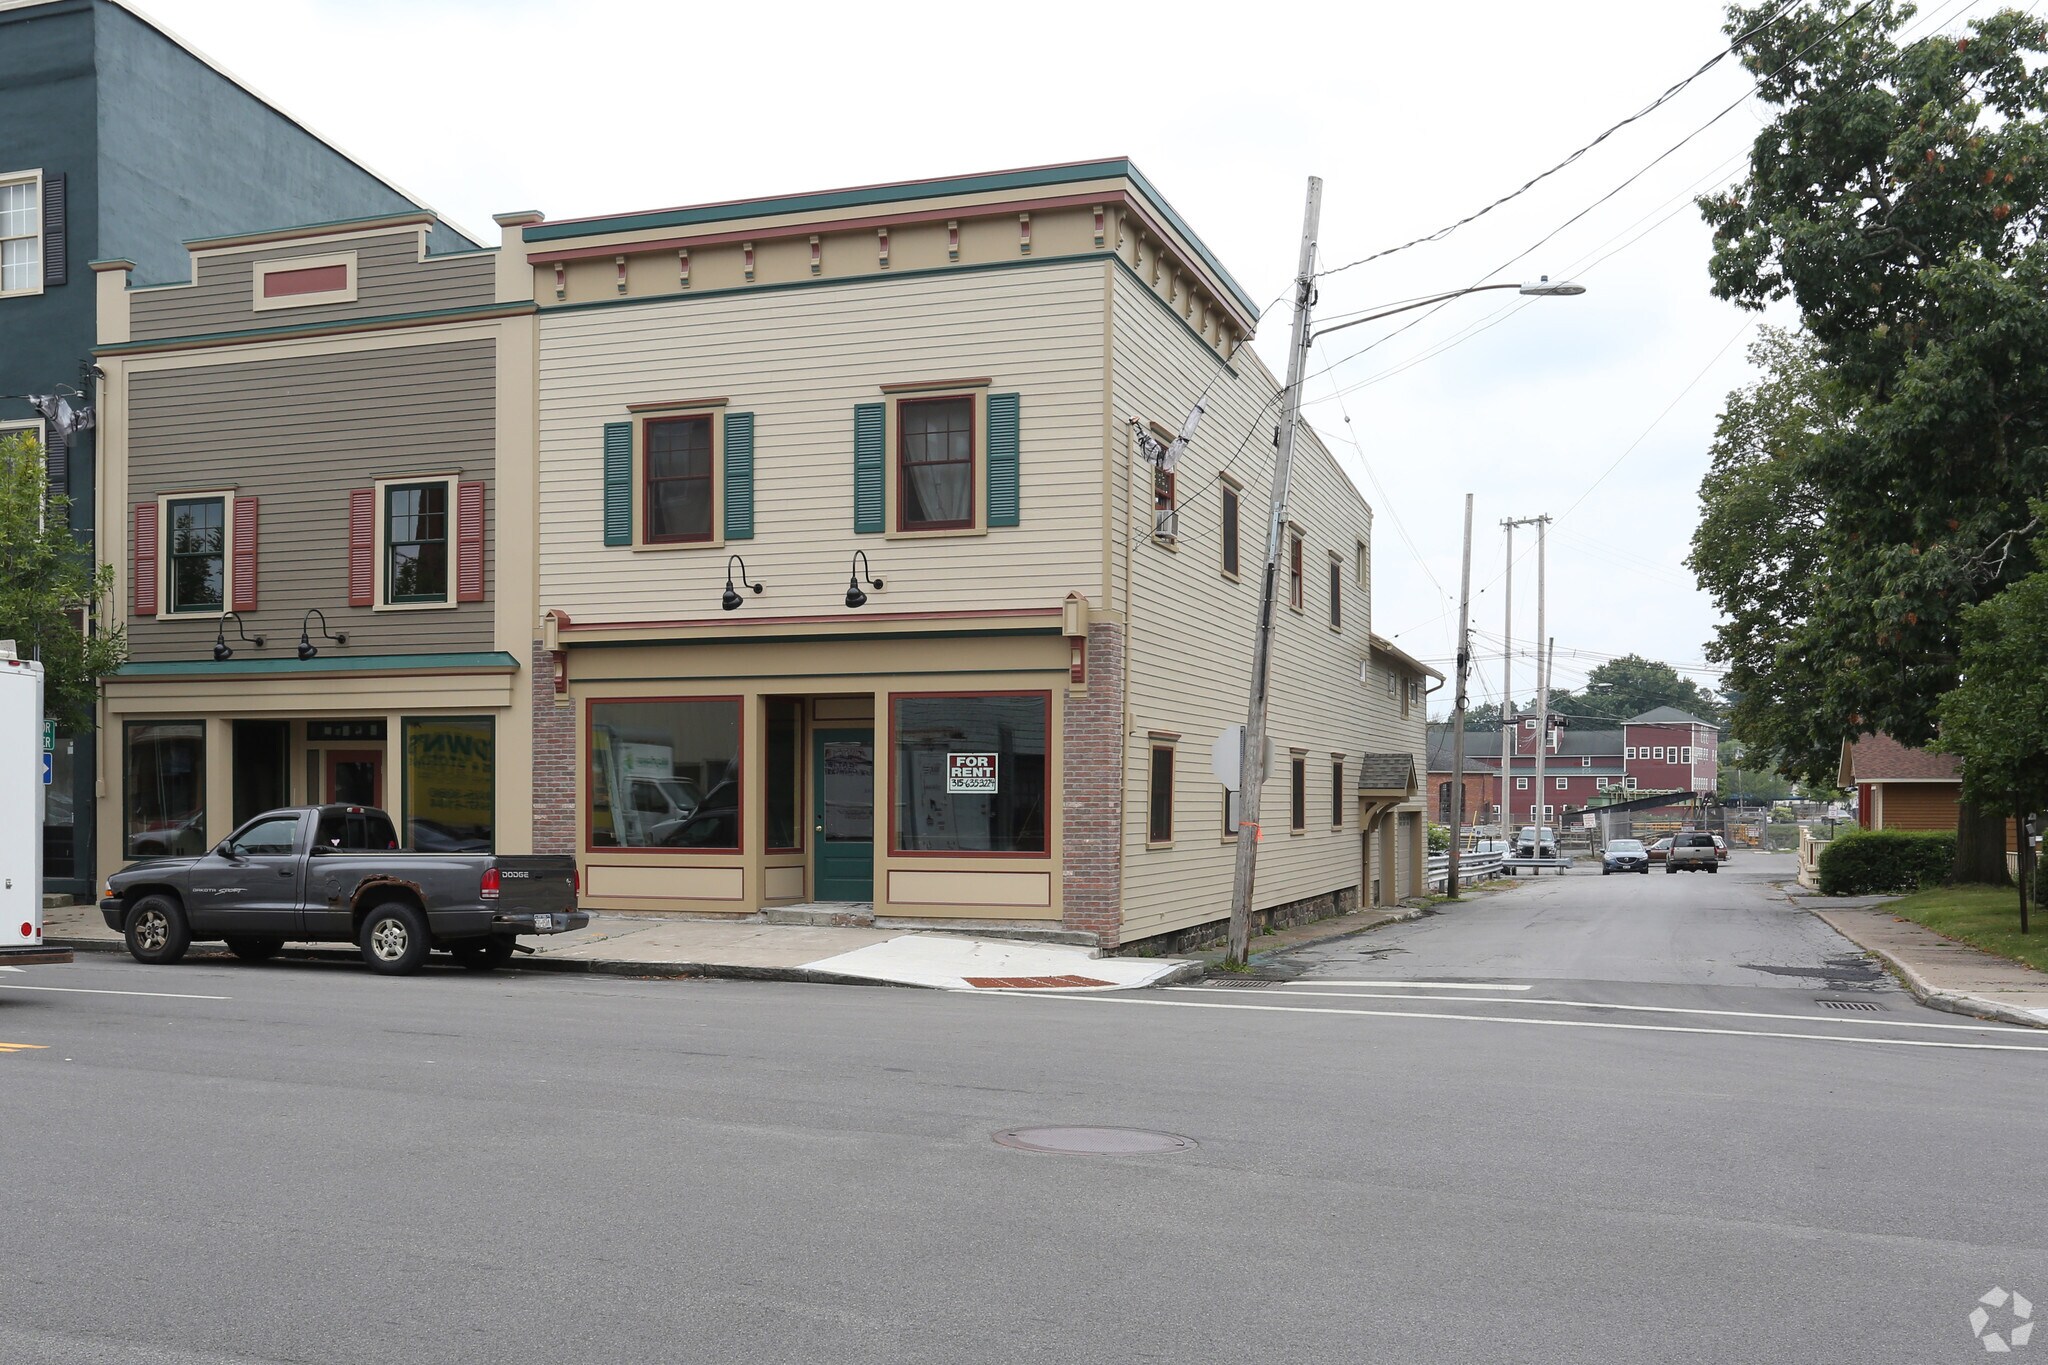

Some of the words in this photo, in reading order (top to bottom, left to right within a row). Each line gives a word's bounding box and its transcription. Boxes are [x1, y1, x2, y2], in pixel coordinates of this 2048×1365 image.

[956, 756, 988, 767] FOR
[951, 767, 994, 777] RENT
[501, 871, 529, 879] DODGE
